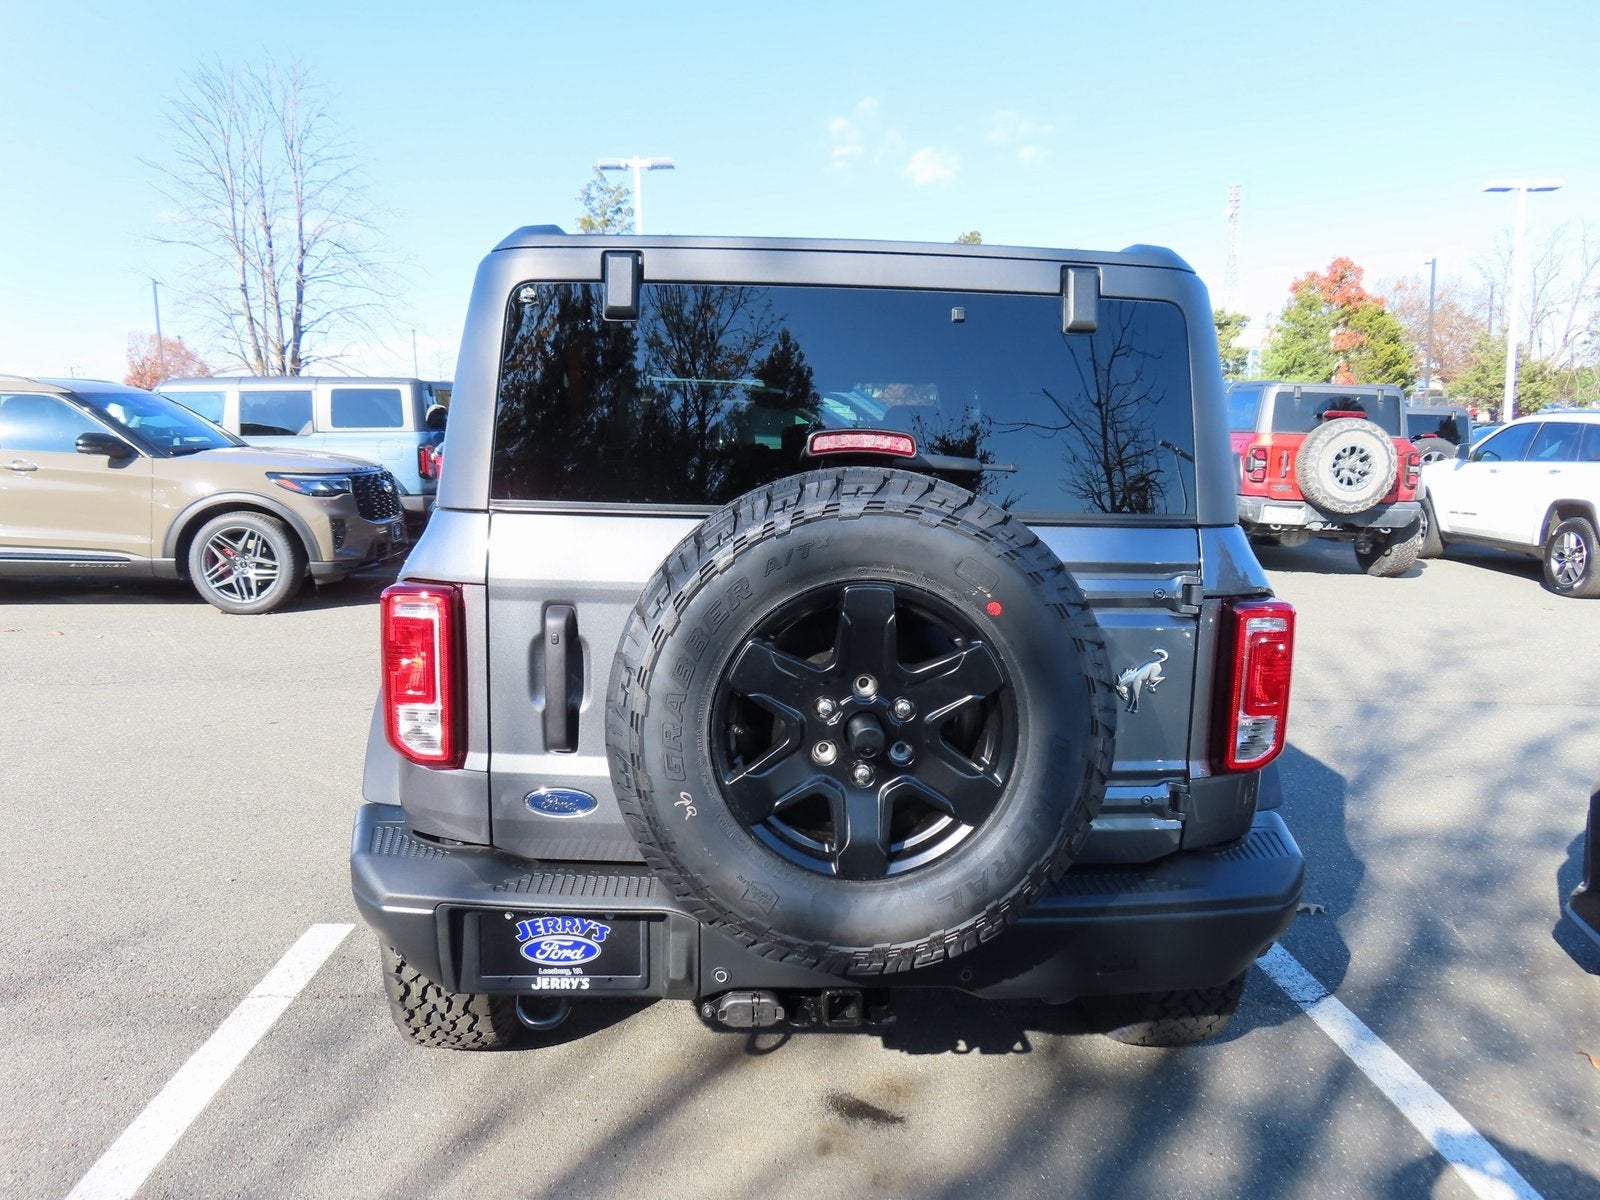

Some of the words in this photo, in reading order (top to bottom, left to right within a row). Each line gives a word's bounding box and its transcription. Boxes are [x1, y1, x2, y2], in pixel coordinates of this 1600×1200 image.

[662, 575, 753, 782] GRABBER
[515, 916, 611, 942] JERRY'S
[535, 940, 586, 960] Ford
[531, 976, 590, 990] JERRY'S
